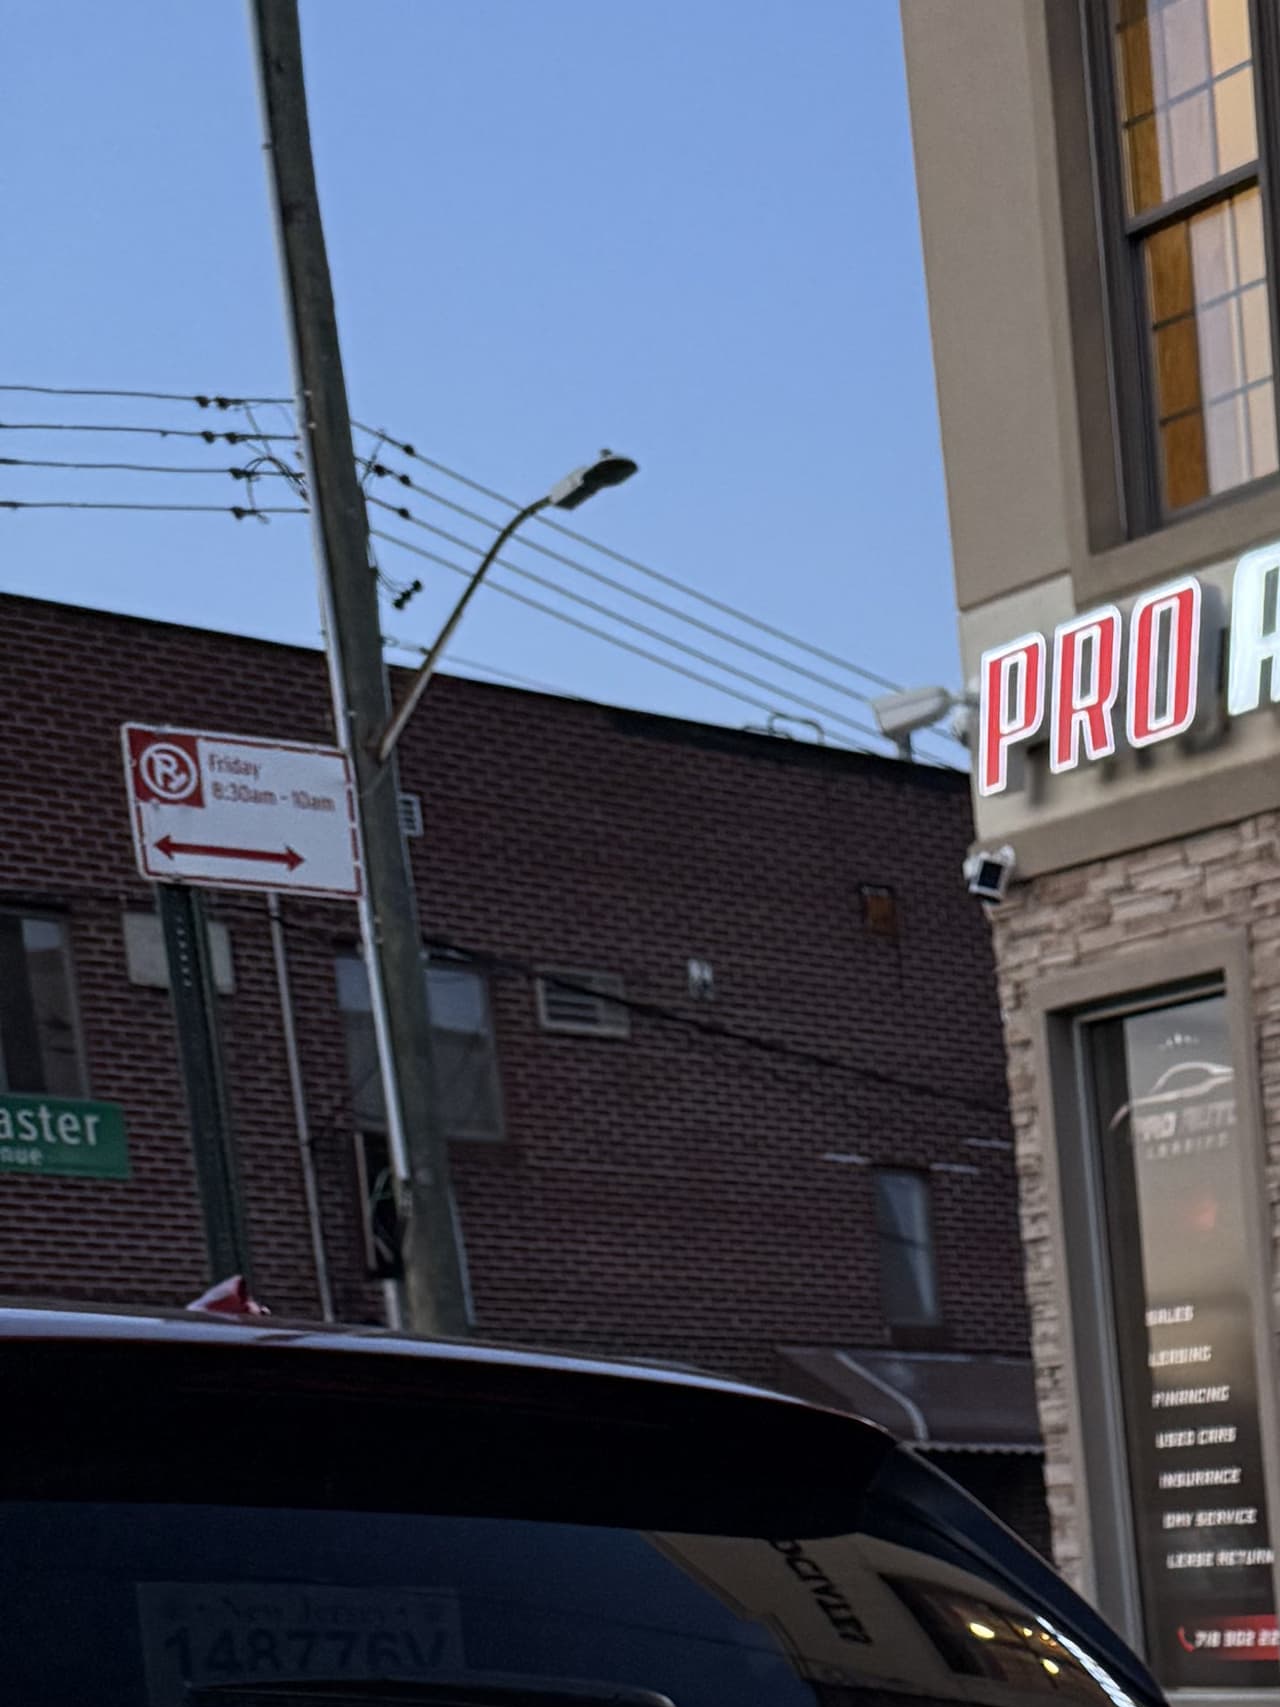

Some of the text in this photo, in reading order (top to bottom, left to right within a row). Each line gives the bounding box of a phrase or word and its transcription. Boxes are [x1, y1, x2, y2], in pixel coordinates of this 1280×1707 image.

[978, 576, 1202, 797] PRO
[208, 753, 262, 781] Friday
[212, 781, 278, 805] 8:30am
[291, 789, 336, 812] 10am
[1146, 1305, 1194, 1327] SALES
[1148, 1346, 1213, 1368] LEASING
[1152, 1385, 1231, 1409] FINANCING
[1156, 1427, 1238, 1449] USED CARS
[1160, 1468, 1242, 1489] INSURANCE
[1195, 1508, 1258, 1528] SERVICE
[1166, 1551, 1214, 1569] LEASE
[1193, 1630, 1222, 1649] 718
[1223, 1630, 1256, 1648] 902
